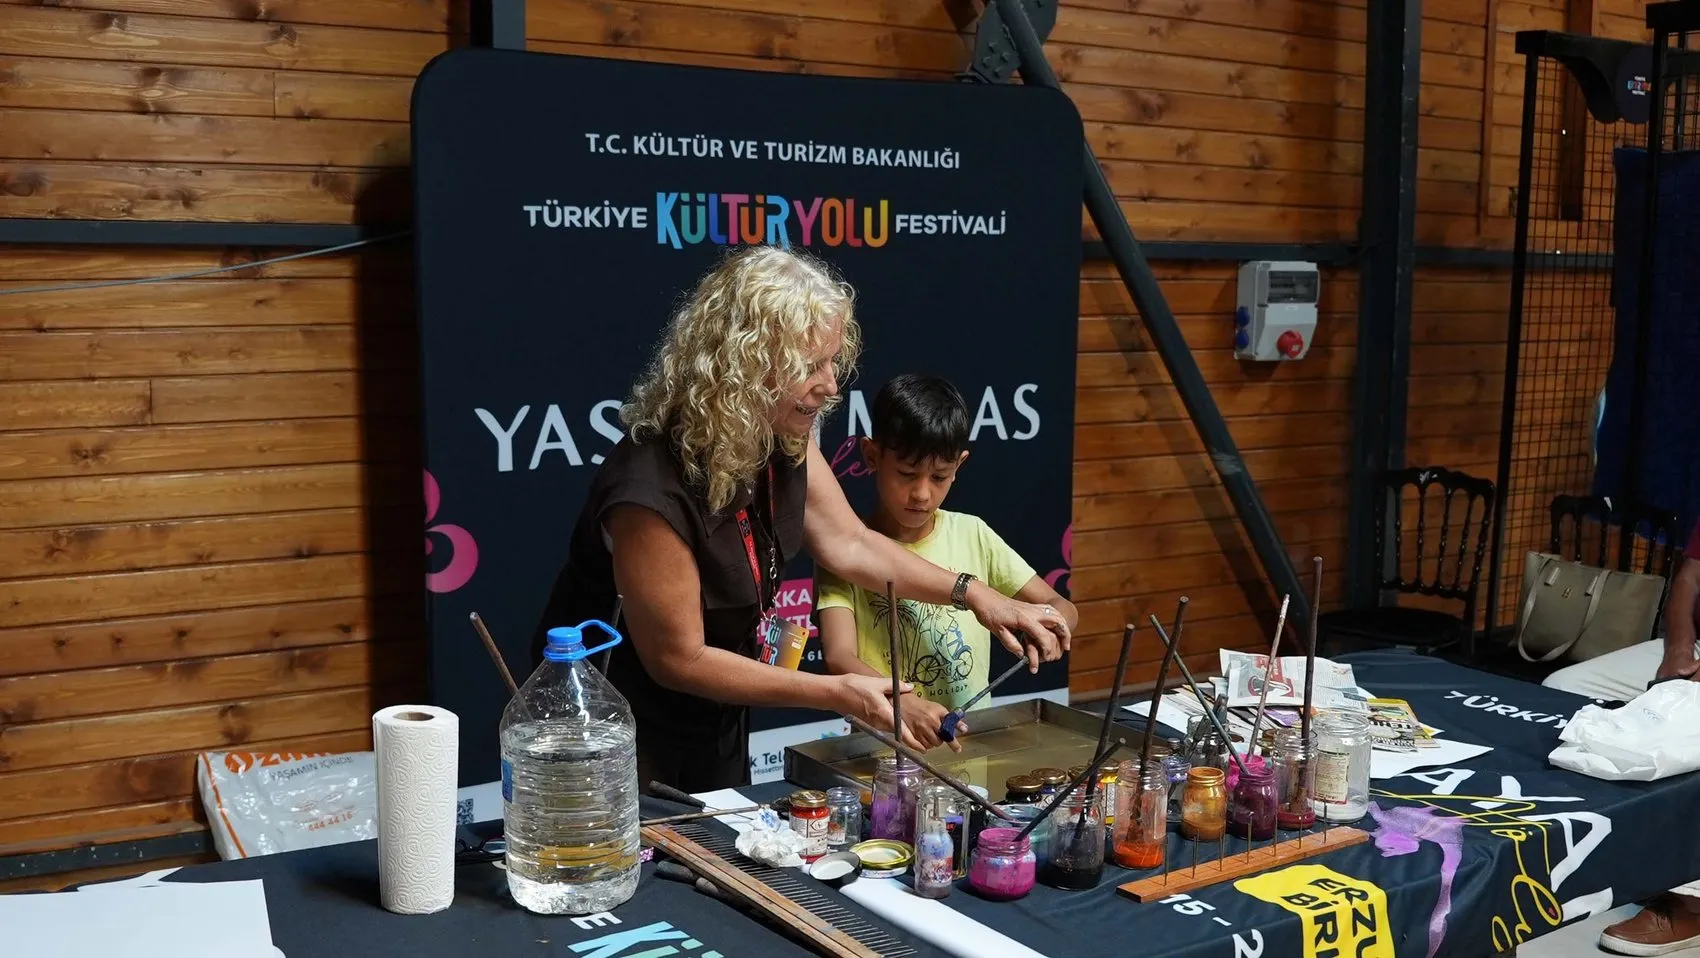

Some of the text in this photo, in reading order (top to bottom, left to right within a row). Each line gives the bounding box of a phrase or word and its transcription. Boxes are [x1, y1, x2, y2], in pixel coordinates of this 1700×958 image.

[585, 132, 960, 169] T.C. KÜLTÜR VE TURİZM BAKANLIĞI
[523, 192, 1006, 249] TÜRKİYE KÜLTÜR YOLU FESTİVALİ
[1159, 893, 1216, 916] 15
